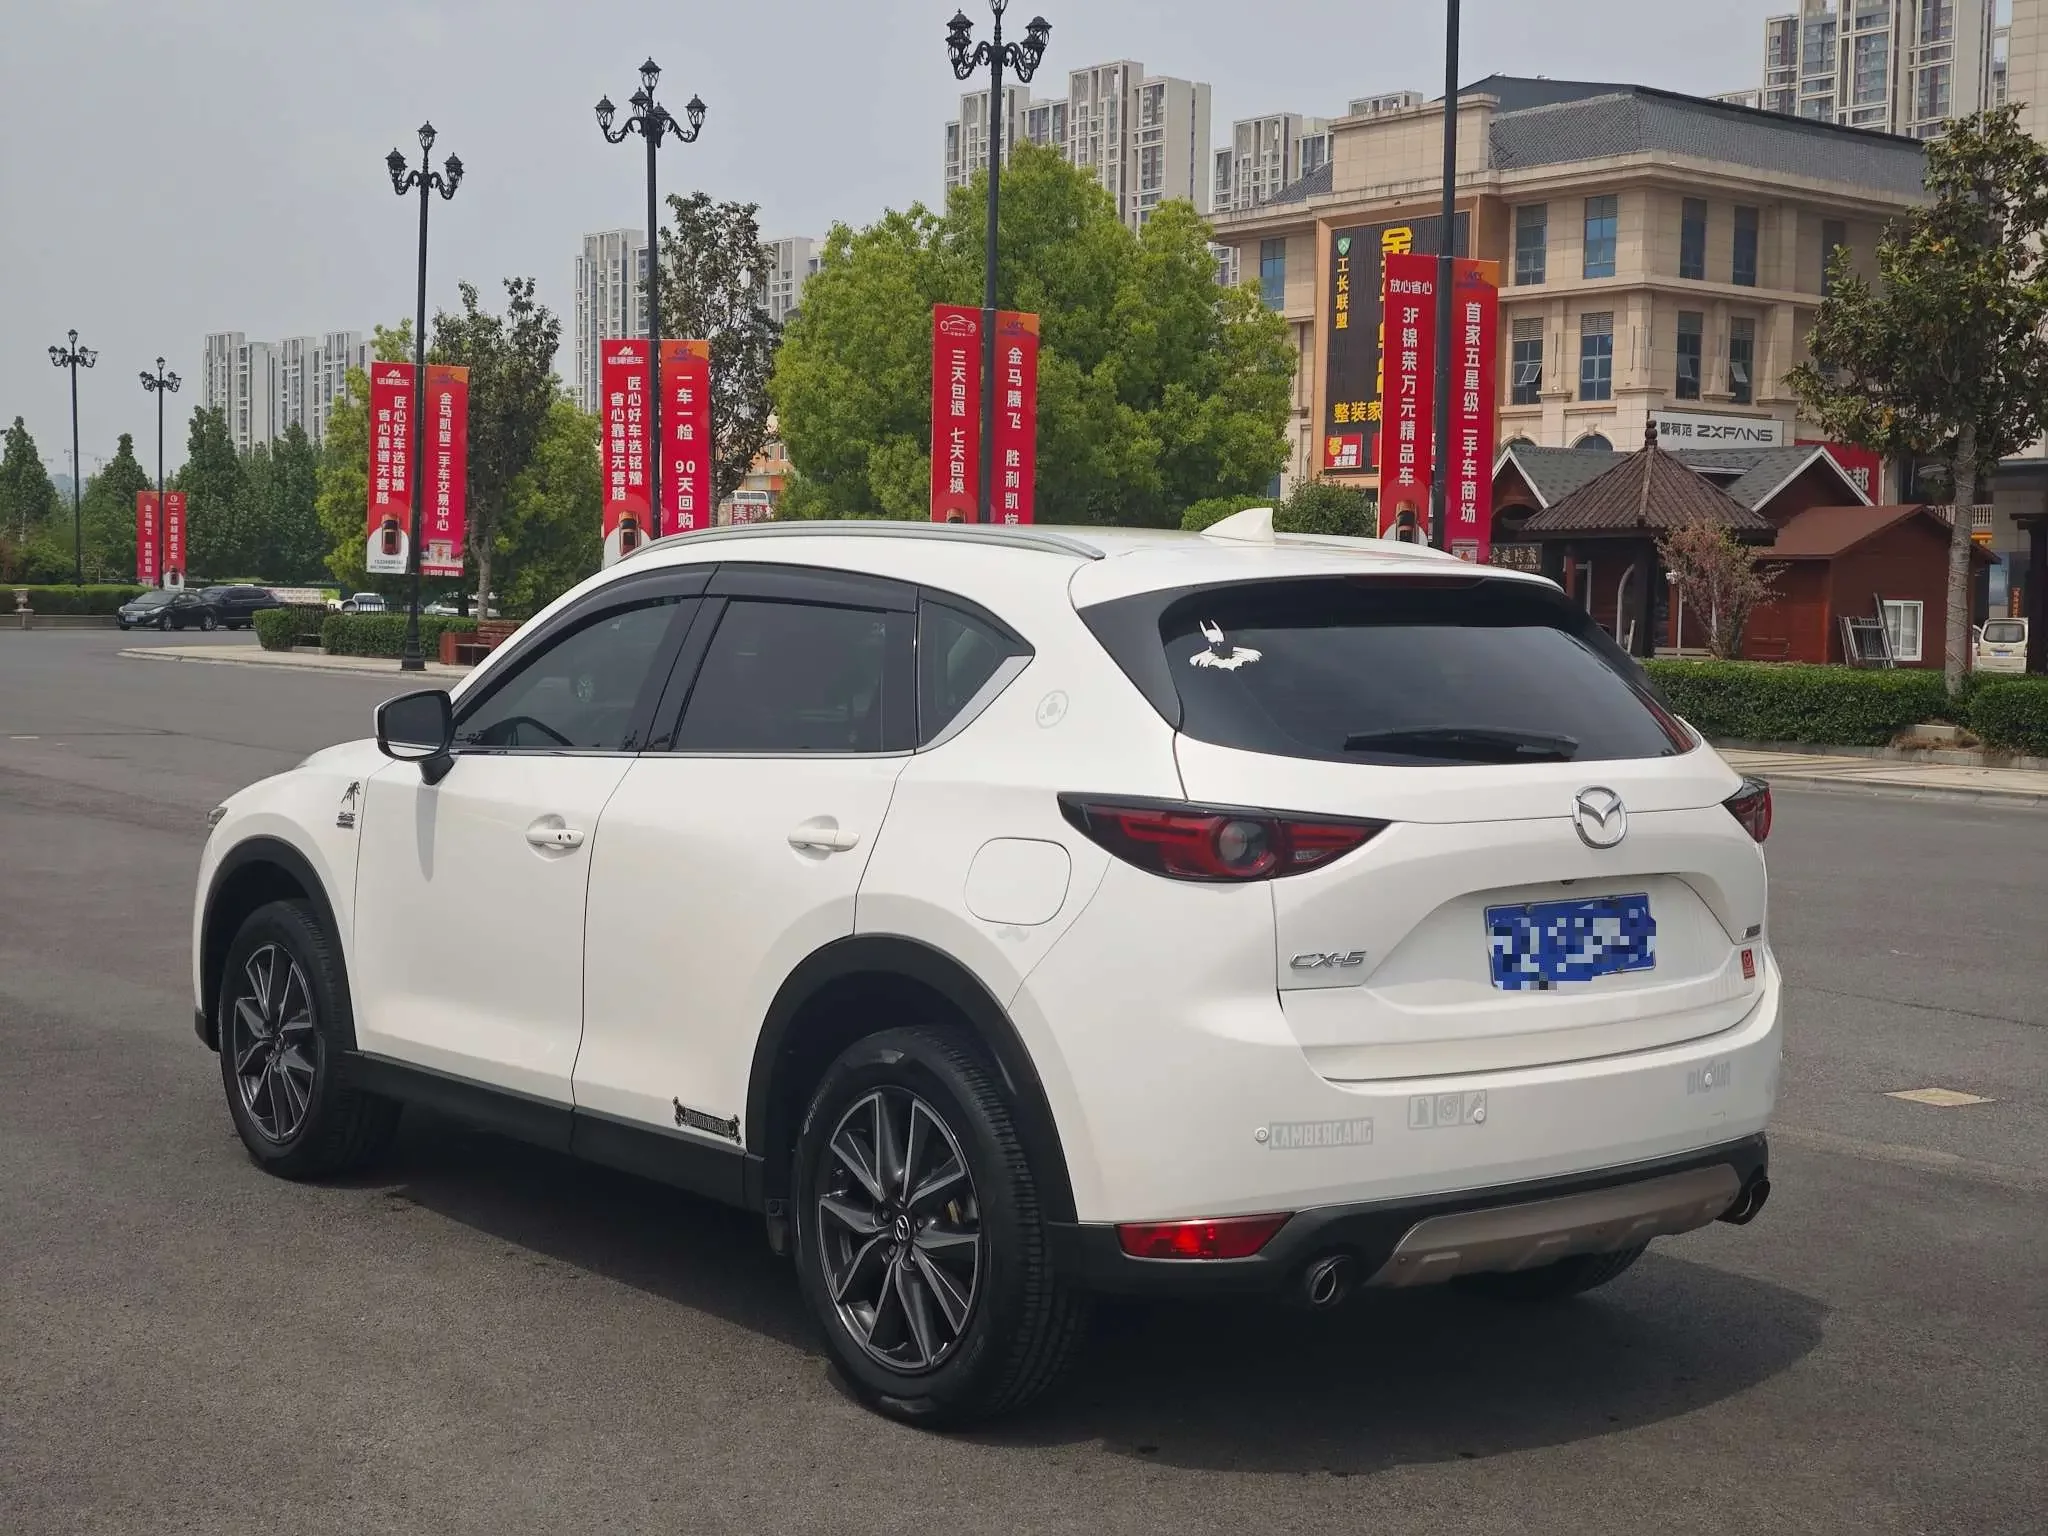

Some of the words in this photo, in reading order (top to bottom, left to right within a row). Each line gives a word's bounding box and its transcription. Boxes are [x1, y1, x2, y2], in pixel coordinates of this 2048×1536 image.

[1336, 257, 1349, 329] 工长联盟
[1390, 279, 1433, 295] 放心省心
[676, 375, 693, 441] 一车一检
[951, 349, 966, 417] 三天包退
[1007, 347, 1023, 429] 金马腾飞
[1460, 302, 1481, 523] 首家五星级二手车商场
[376, 409, 391, 505] 省心靠谱无套路
[393, 396, 407, 492] 匠心好车选铭豫
[436, 392, 452, 531] 金马凯旋二手车交易中心
[611, 392, 626, 500] 省心靠谱无套路
[627, 376, 643, 486] 匠心好车选铭豫
[950, 427, 965, 494] 七天包换
[1697, 424, 1773, 442] ZXFANS
[675, 460, 696, 529] 90天回购
[1289, 951, 1367, 969] CX-5
